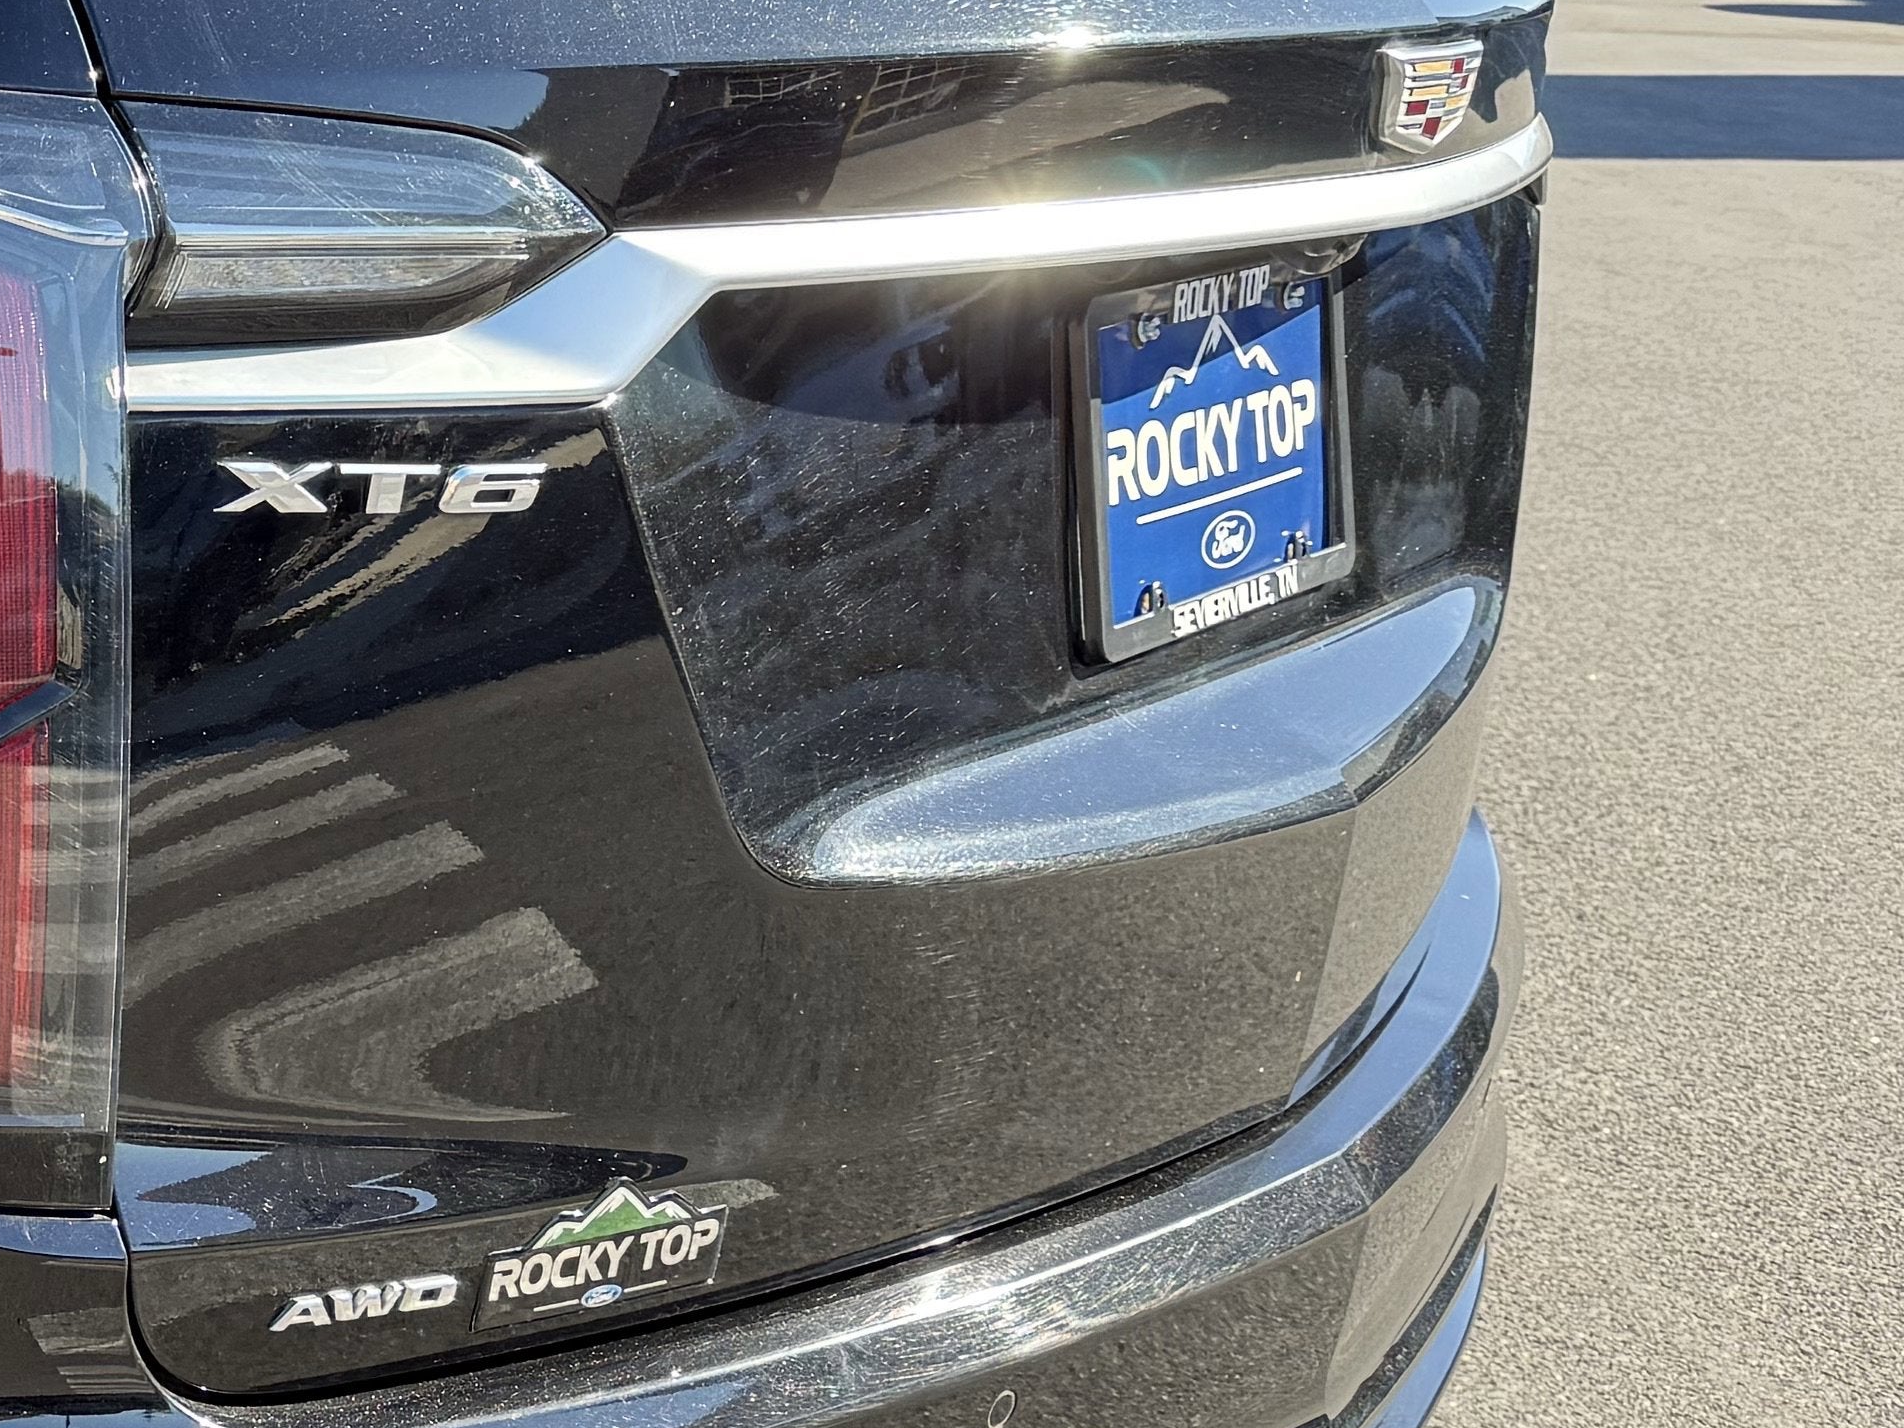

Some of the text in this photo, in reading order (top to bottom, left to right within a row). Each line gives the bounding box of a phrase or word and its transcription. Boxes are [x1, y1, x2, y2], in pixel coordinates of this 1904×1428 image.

[1173, 264, 1271, 323] ROCKY TOP
[1106, 379, 1316, 507] ROCKY TOP
[213, 461, 549, 514] XT6
[1275, 564, 1299, 599] TN
[489, 1217, 720, 1303] ROCKY TOP
[269, 1273, 459, 1332] AWD
